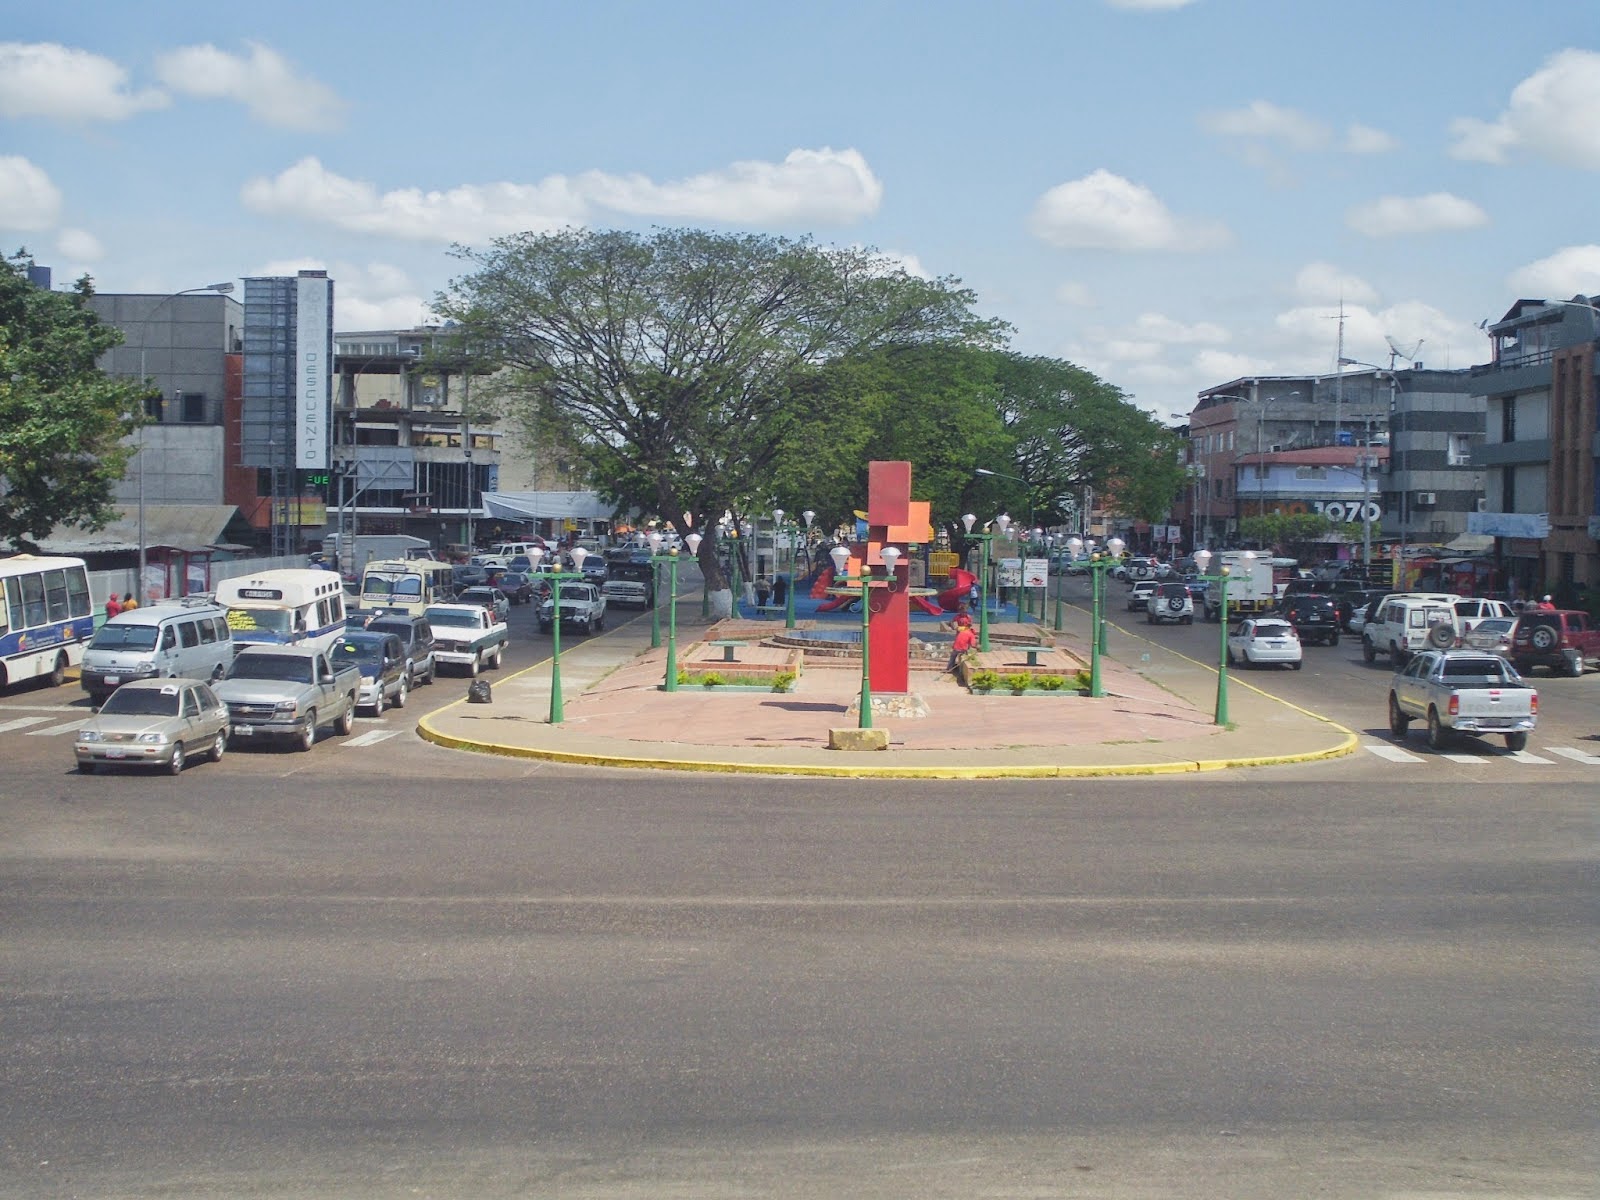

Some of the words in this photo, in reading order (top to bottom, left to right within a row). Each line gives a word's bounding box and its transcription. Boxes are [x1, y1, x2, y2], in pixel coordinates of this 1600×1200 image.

[305, 352, 317, 460] DESCUENTO
[1314, 501, 1381, 523] 1070
[1465, 703, 1524, 713] TOYOTA
